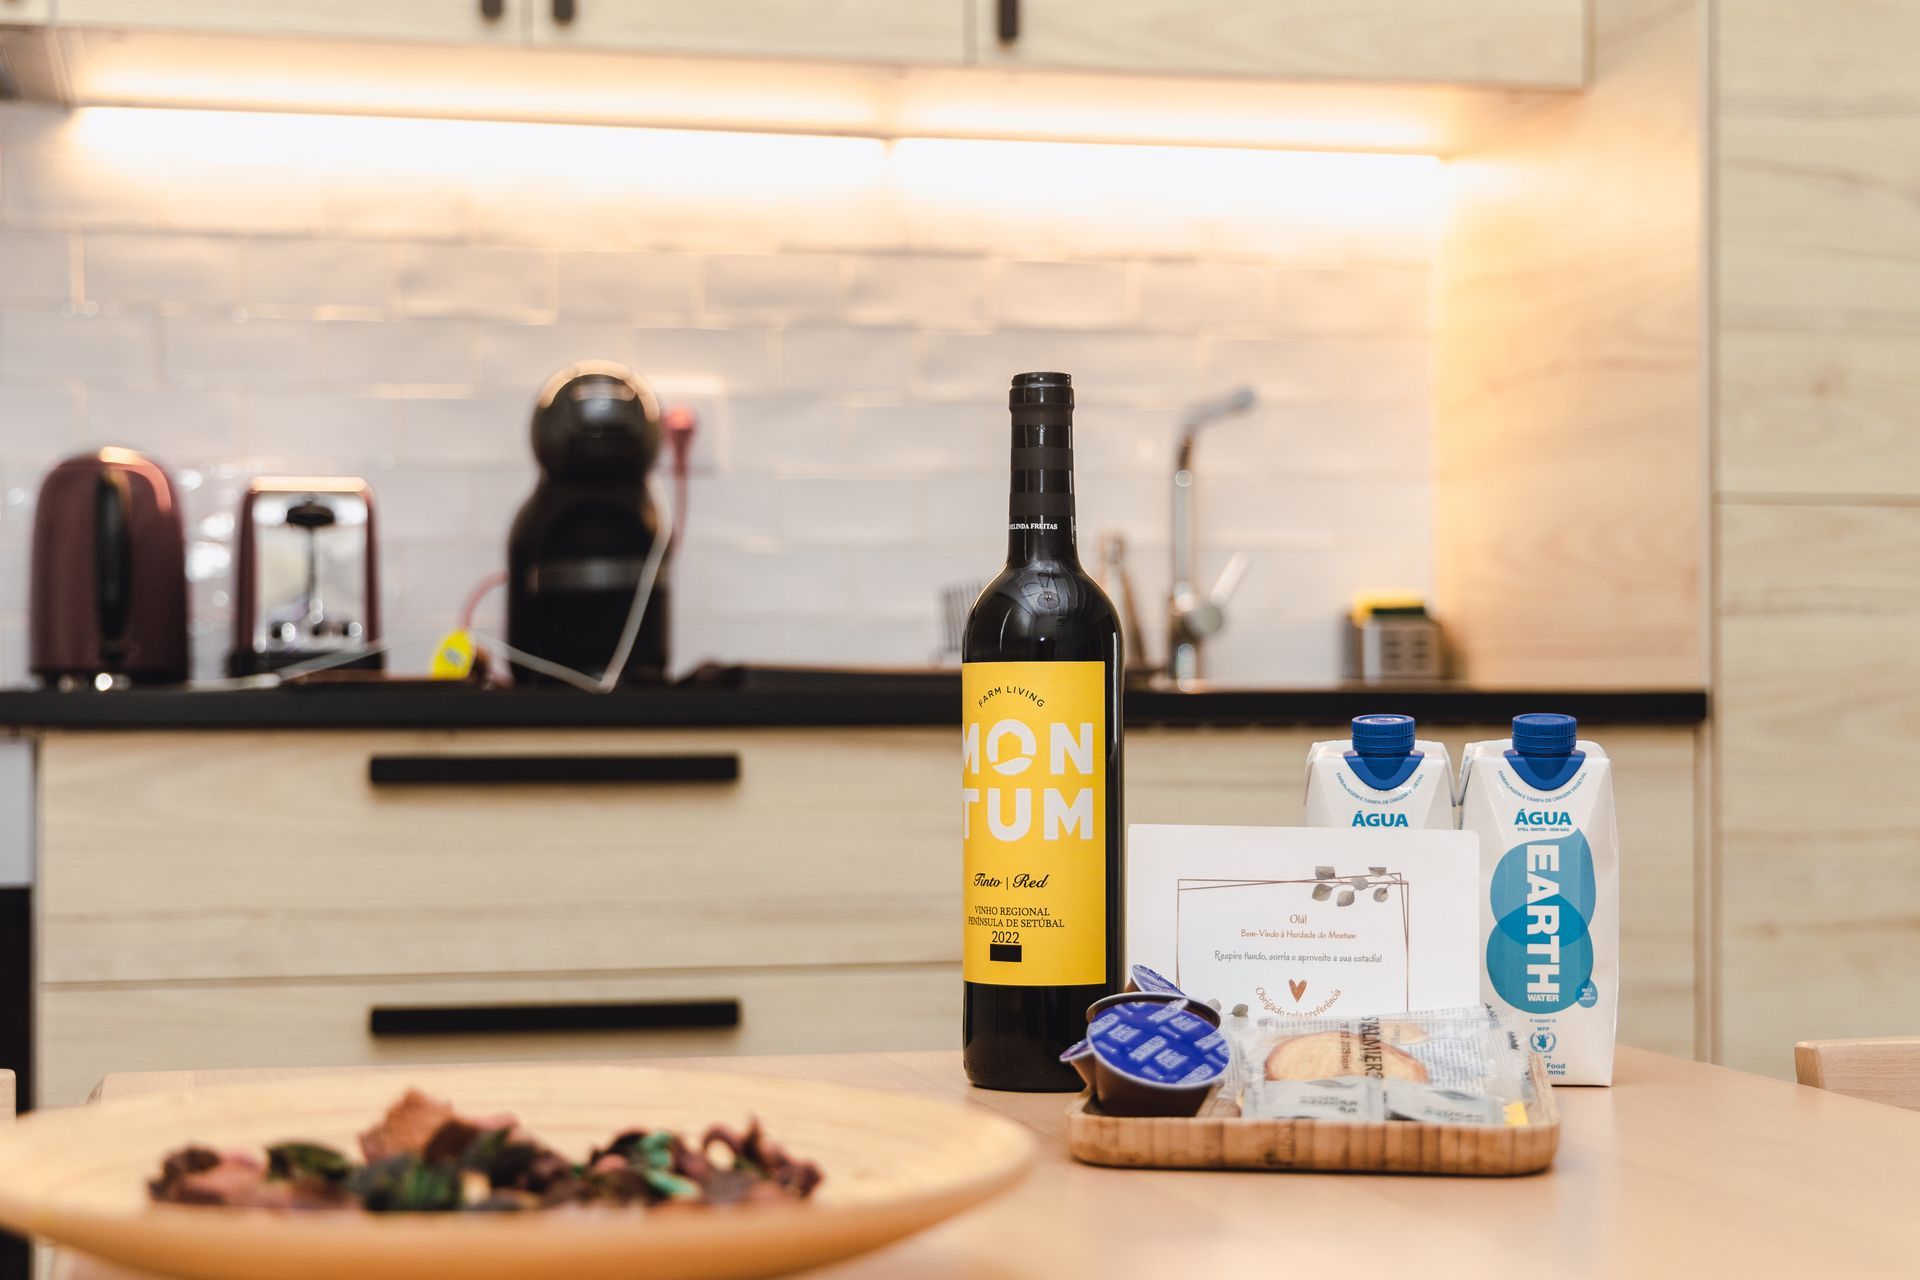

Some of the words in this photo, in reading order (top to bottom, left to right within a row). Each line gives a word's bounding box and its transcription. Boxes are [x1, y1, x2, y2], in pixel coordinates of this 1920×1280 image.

[1030, 522, 1058, 530] FREITAS
[978, 686, 1002, 708] FARM
[1006, 685, 1045, 708] LIVING
[962, 788, 1094, 842] TUM
[1351, 810, 1409, 828] ÁGUA
[1514, 808, 1573, 826] ÁGUA
[973, 872, 1003, 887] Tinto
[1012, 873, 1050, 889] Red
[974, 905, 998, 916] VINHO
[1000, 906, 1051, 916] REGIONAL
[1006, 918, 1019, 928] DE
[1020, 917, 1065, 928] SETÚBAL
[1289, 913, 1307, 925] Olá!
[1526, 844, 1560, 993] EARTH
[991, 930, 1020, 944] 2022
[1240, 928, 1280, 938] Bem-Vindo
[1317, 931, 1327, 939] do
[1214, 949, 1243, 963] Respire
[1268, 952, 1290, 961] sorria
[1297, 952, 1332, 964] aproveite
[1338, 955, 1352, 963] sua
[1255, 987, 1286, 1016] Obrigado
[1526, 993, 1560, 1002] WATER
